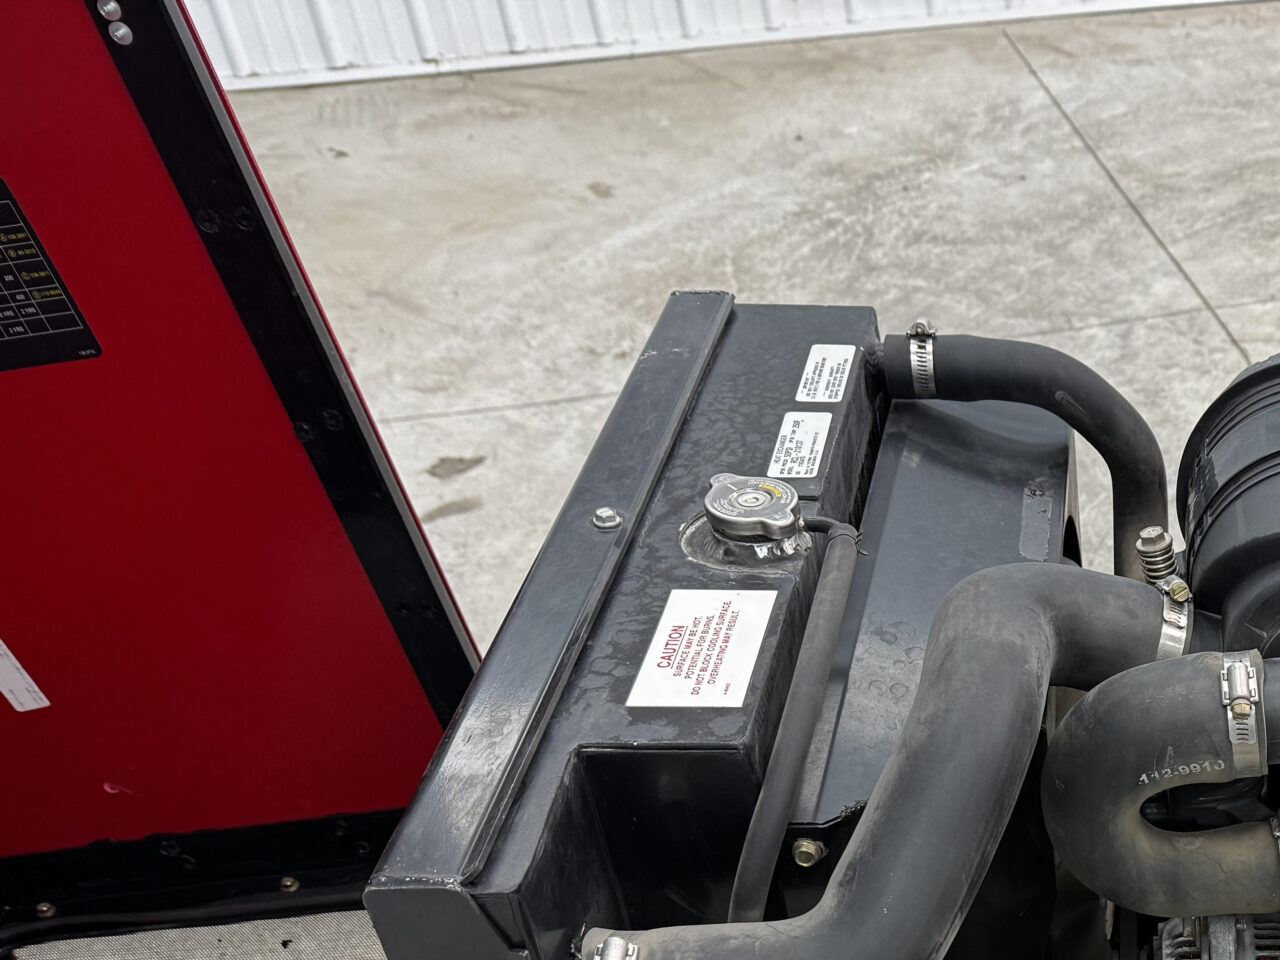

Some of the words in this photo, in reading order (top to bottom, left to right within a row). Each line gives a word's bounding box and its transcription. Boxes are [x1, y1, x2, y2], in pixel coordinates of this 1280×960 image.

[692, 616, 702, 628] HOT.
[715, 601, 732, 626] SURFACE.
[725, 610, 740, 631] RESULT.
[687, 629, 698, 637] BE
[700, 614, 714, 634] BURNS.
[656, 625, 685, 668] CAUTION
[683, 637, 694, 649] MAY
[695, 635, 707, 646] FOR
[706, 626, 722, 651] COOLING
[721, 631, 731, 643] MAY
[672, 650, 690, 676] SURFACE
[683, 647, 703, 679] POTENTIAL
[698, 652, 712, 672] BLOCK
[706, 644, 727, 684] OVERHEATING
[694, 673, 704, 685] NOT
[690, 686, 700, 695] DO
